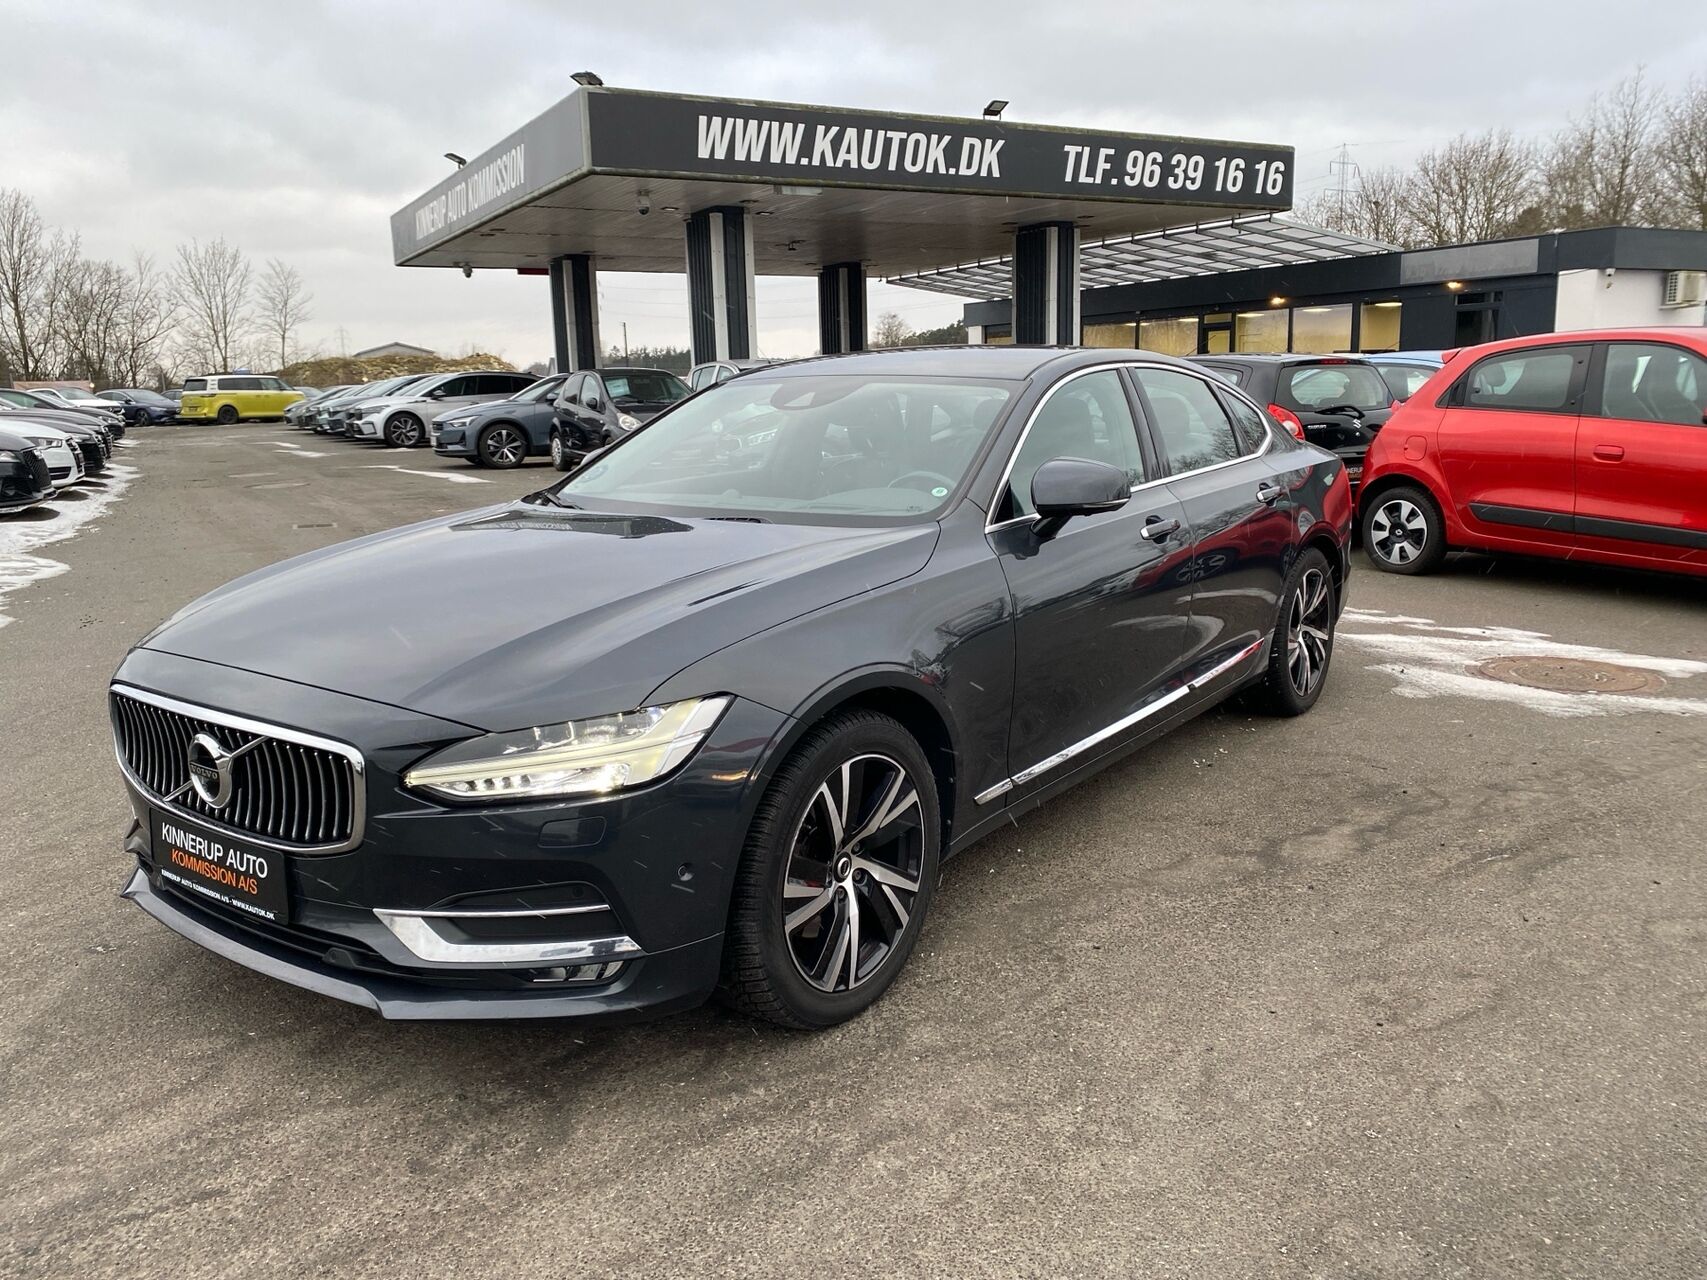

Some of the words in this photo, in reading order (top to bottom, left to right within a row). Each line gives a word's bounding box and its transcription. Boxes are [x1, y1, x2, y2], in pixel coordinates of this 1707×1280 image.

[698, 115, 1005, 178] WWW.KAUTOK.DK
[1064, 145, 1118, 186] TLF.
[1124, 150, 1164, 188] 96
[1168, 153, 1205, 191] 39
[1214, 157, 1246, 193] 16
[1255, 160, 1286, 196] 16
[447, 182, 467, 223] AUTO
[468, 144, 525, 212] KOMMISSION
[190, 764, 218, 779] VOLVO
[162, 822, 223, 862] KINNERUP
[226, 849, 268, 878] AUTO
[172, 848, 236, 888] KOMMISSION
[238, 875, 258, 895] A/S
